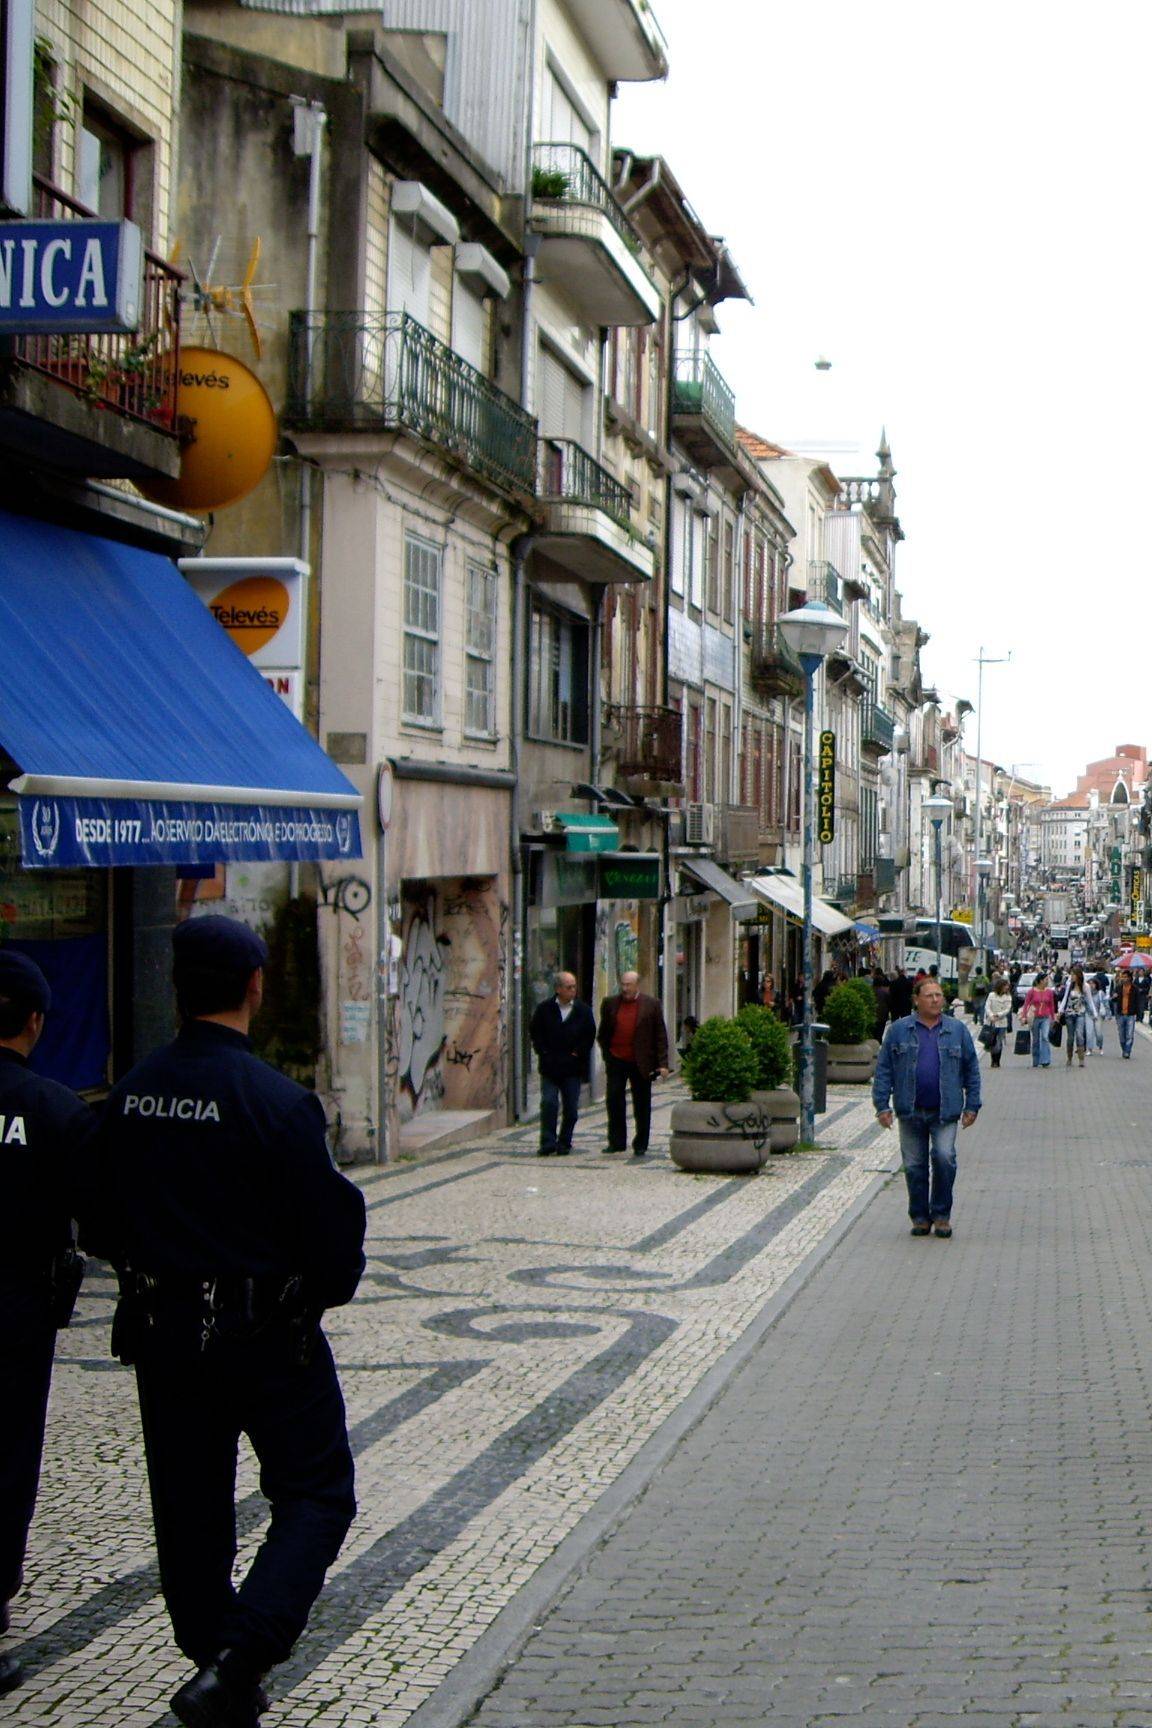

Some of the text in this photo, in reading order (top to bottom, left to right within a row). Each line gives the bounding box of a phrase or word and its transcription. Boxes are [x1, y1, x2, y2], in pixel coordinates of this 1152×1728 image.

[209, 604, 280, 625] Televés
[75, 819, 111, 843] DESDE
[124, 1094, 221, 1122] POLICIA
